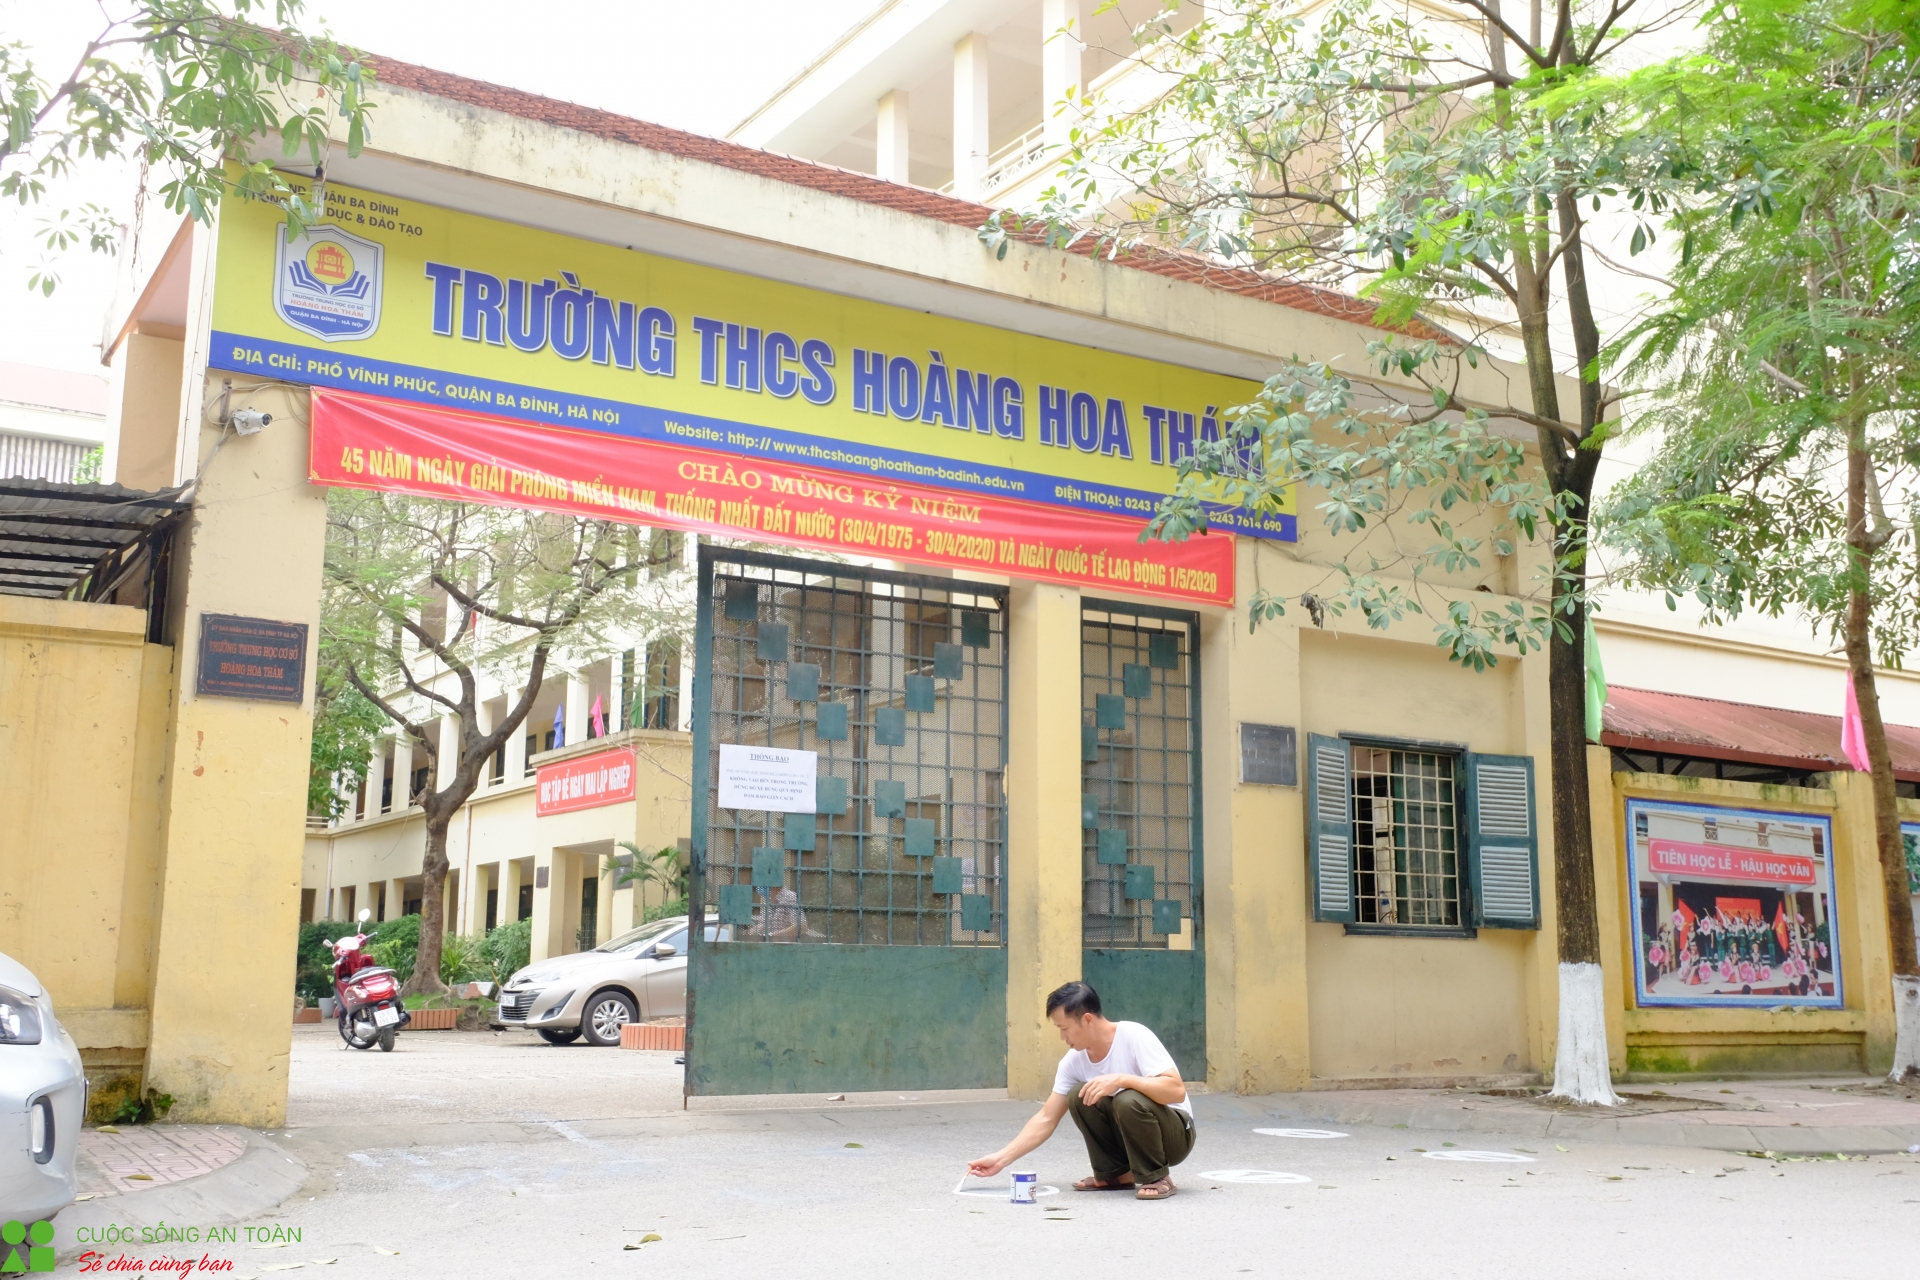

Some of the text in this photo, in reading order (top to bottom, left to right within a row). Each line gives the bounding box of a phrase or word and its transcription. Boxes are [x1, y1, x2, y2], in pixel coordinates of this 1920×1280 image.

[326, 206, 353, 222] DỤC
[356, 214, 366, 227] &
[368, 215, 395, 231] ĐÀO
[399, 222, 423, 237] TẠO
[350, 197, 366, 209] BA
[370, 200, 399, 216] ĐÌNH
[290, 298, 364, 318] HOÀNG HOA THÁM
[341, 318, 351, 326] HÀ
[425, 261, 676, 377] TRƯỜNG
[692, 315, 836, 405] THCS
[852, 347, 1025, 446] HOÀNG
[1037, 384, 1133, 460] HOA
[233, 347, 263, 365] ĐỊA
[268, 353, 302, 371] CHỈ:
[307, 360, 343, 378] PHỐ
[347, 366, 389, 386] VĨNH
[394, 376, 441, 396] PHÚC,
[445, 384, 491, 404] QUẬN
[496, 392, 516, 408] BA
[520, 395, 563, 417] ĐÌNH,
[567, 404, 588, 420] HÀ
[592, 408, 620, 426] NỘI
[664, 420, 724, 442] Website:
[1055, 485, 1081, 503] ĐIỆN
[1084, 490, 1122, 509] THOẠI:
[1124, 497, 1151, 512] 0243
[1209, 510, 1234, 525] 0243
[1263, 519, 1282, 532] 690
[678, 461, 982, 524] CHÀO MỪNG KỶ NIỆM
[341, 446, 364, 474] 45
[369, 446, 412, 481] NĂM
[417, 454, 465, 487] NGÀY
[470, 457, 506, 493] GIẢI
[511, 469, 568, 501] PHÓNG
[572, 474, 615, 508] MIỀN
[665, 487, 716, 523] THỐNG
[720, 496, 759, 529] NHẤT
[763, 500, 792, 534] ĐẤT
[795, 508, 835, 539] NƯỚC
[839, 517, 913, 550] (30/4/1975
[926, 529, 995, 564] 30/4/2020)
[999, 537, 1015, 565] VÀ
[1018, 542, 1054, 570] NGÀY
[1055, 544, 1088, 574] QUỐC
[1091, 548, 1107, 578] TẾ
[1108, 558, 1131, 581] LAO
[1134, 558, 1166, 588] ĐỘNG
[1169, 566, 1217, 594] 1/5/2020
[239, 643, 262, 656] TRUNG
[263, 646, 278, 660] HỌC
[279, 647, 288, 659] CƠ
[221, 661, 284, 679] HOÀNG HOA THÁM
[750, 753, 790, 763] THÔNG BÁO
[552, 775, 562, 806] TẬP
[585, 771, 596, 796] MAI
[597, 765, 608, 798] LẬP
[609, 760, 631, 794] NGHIỆP
[1657, 848, 1687, 866] TIÊN
[1690, 854, 1716, 872] HỌC
[1718, 852, 1732, 870] LỄ
[1741, 858, 1764, 876] HẬU
[1766, 863, 1787, 878] HỌC
[1789, 862, 1810, 878] VĂN
